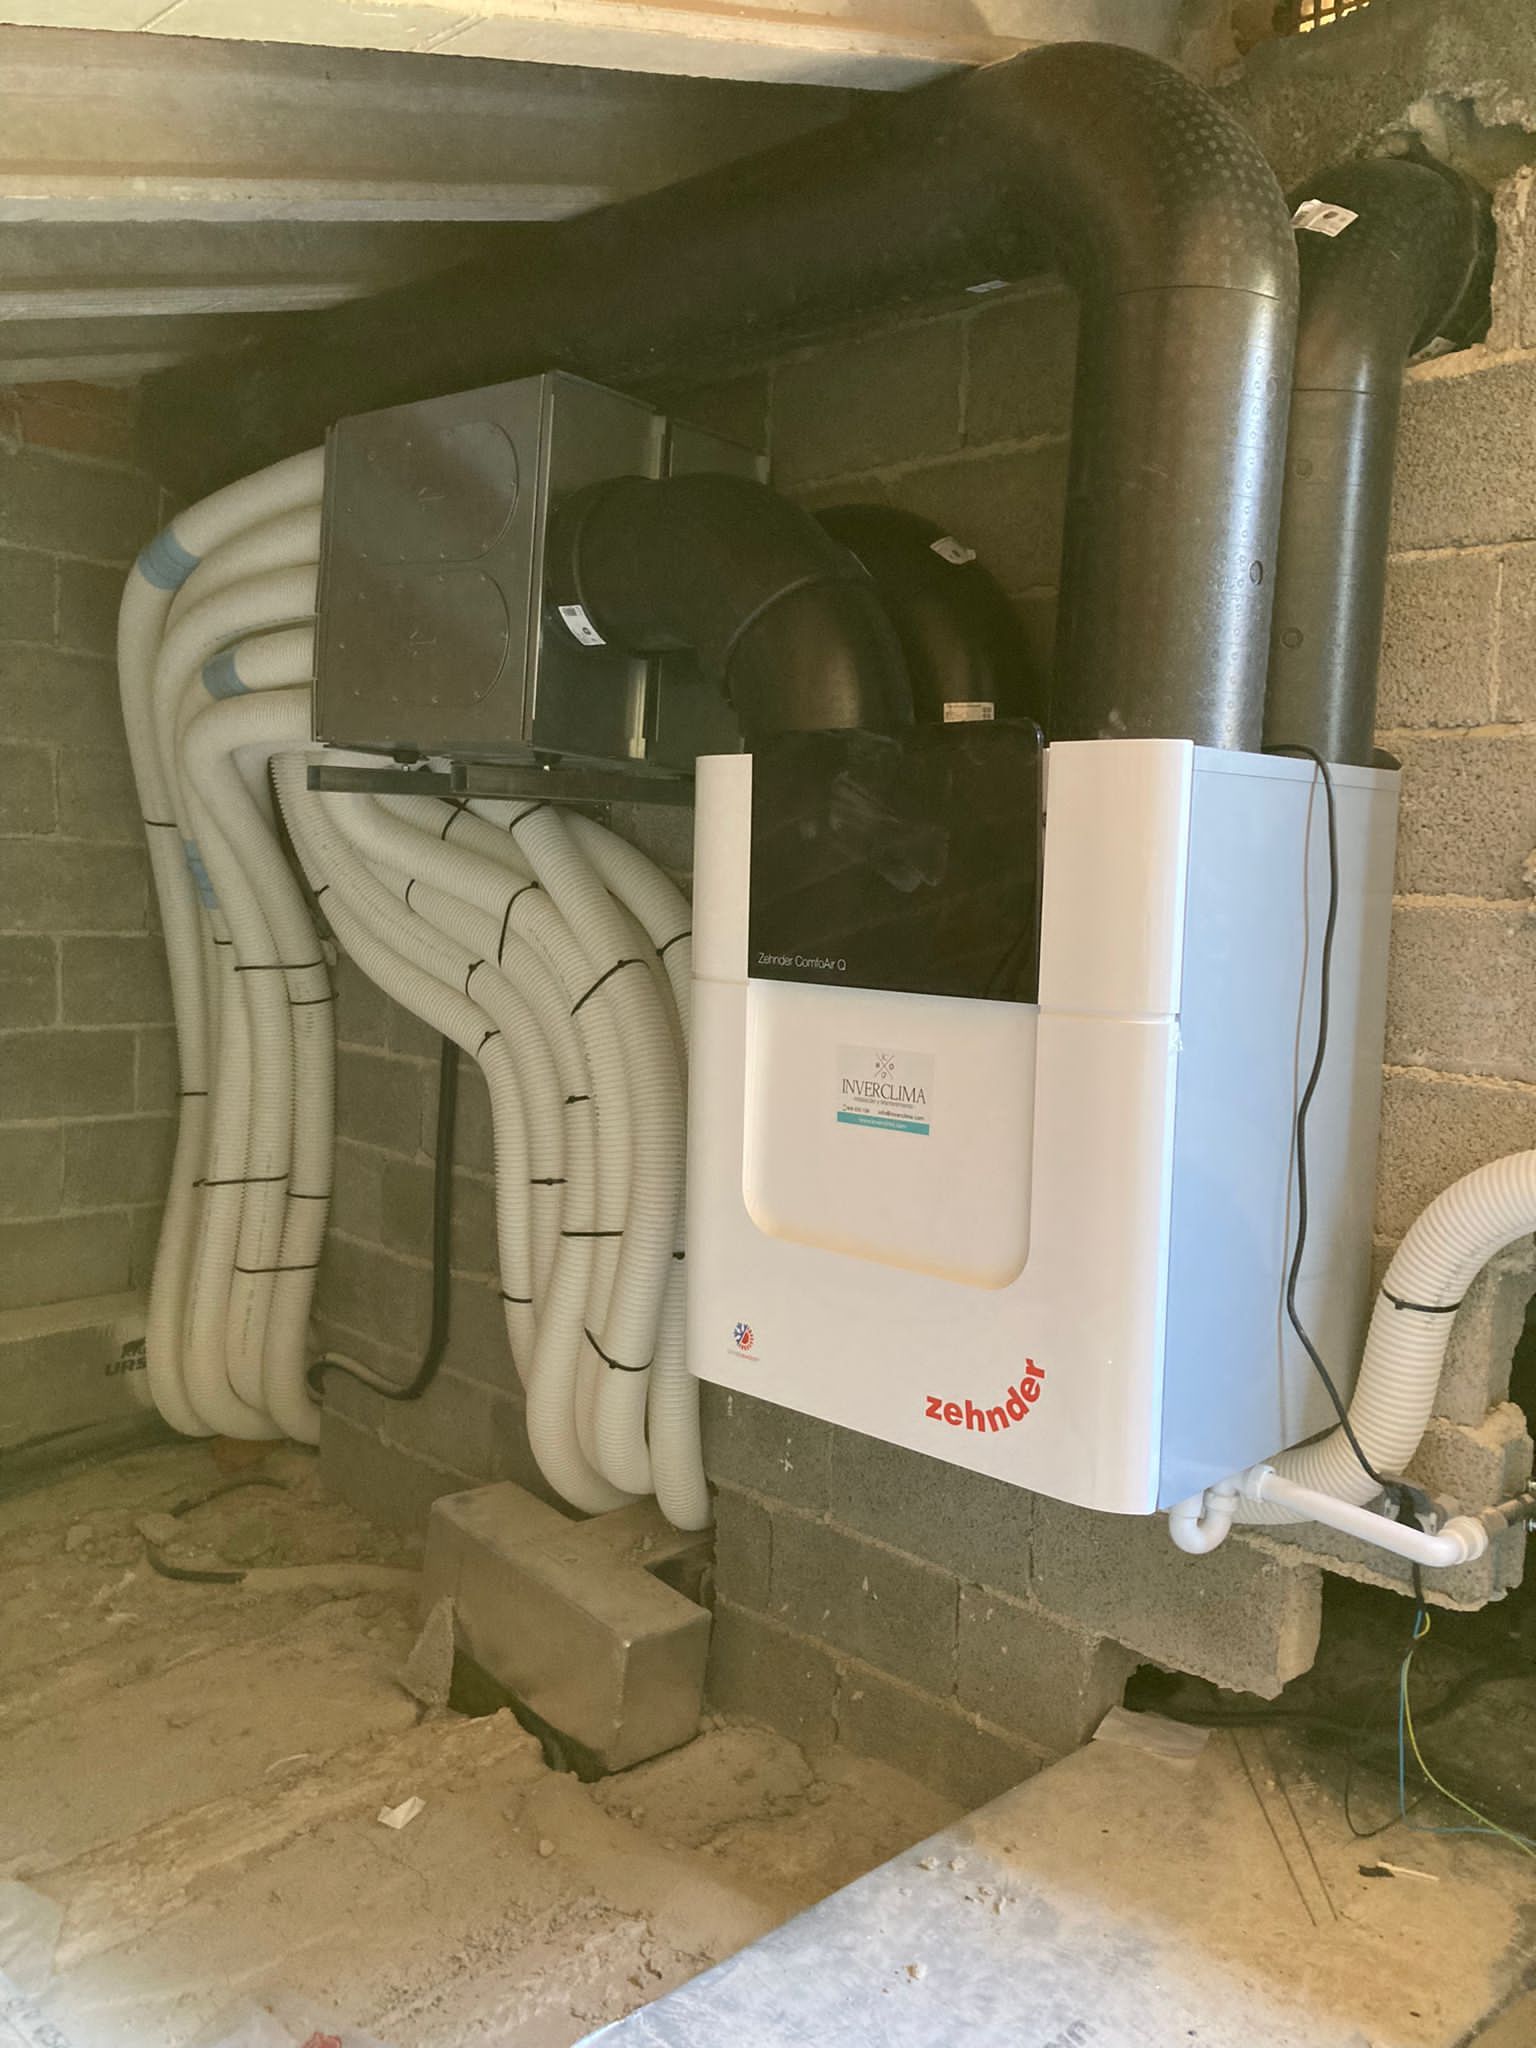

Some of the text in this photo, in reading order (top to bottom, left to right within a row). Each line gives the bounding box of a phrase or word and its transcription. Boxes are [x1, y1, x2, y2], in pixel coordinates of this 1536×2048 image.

[758, 952, 847, 971] Zehnder ComfoAir Q
[842, 1078, 926, 1105] INVERCLIMA
[925, 1357, 1045, 1432] zehnder
